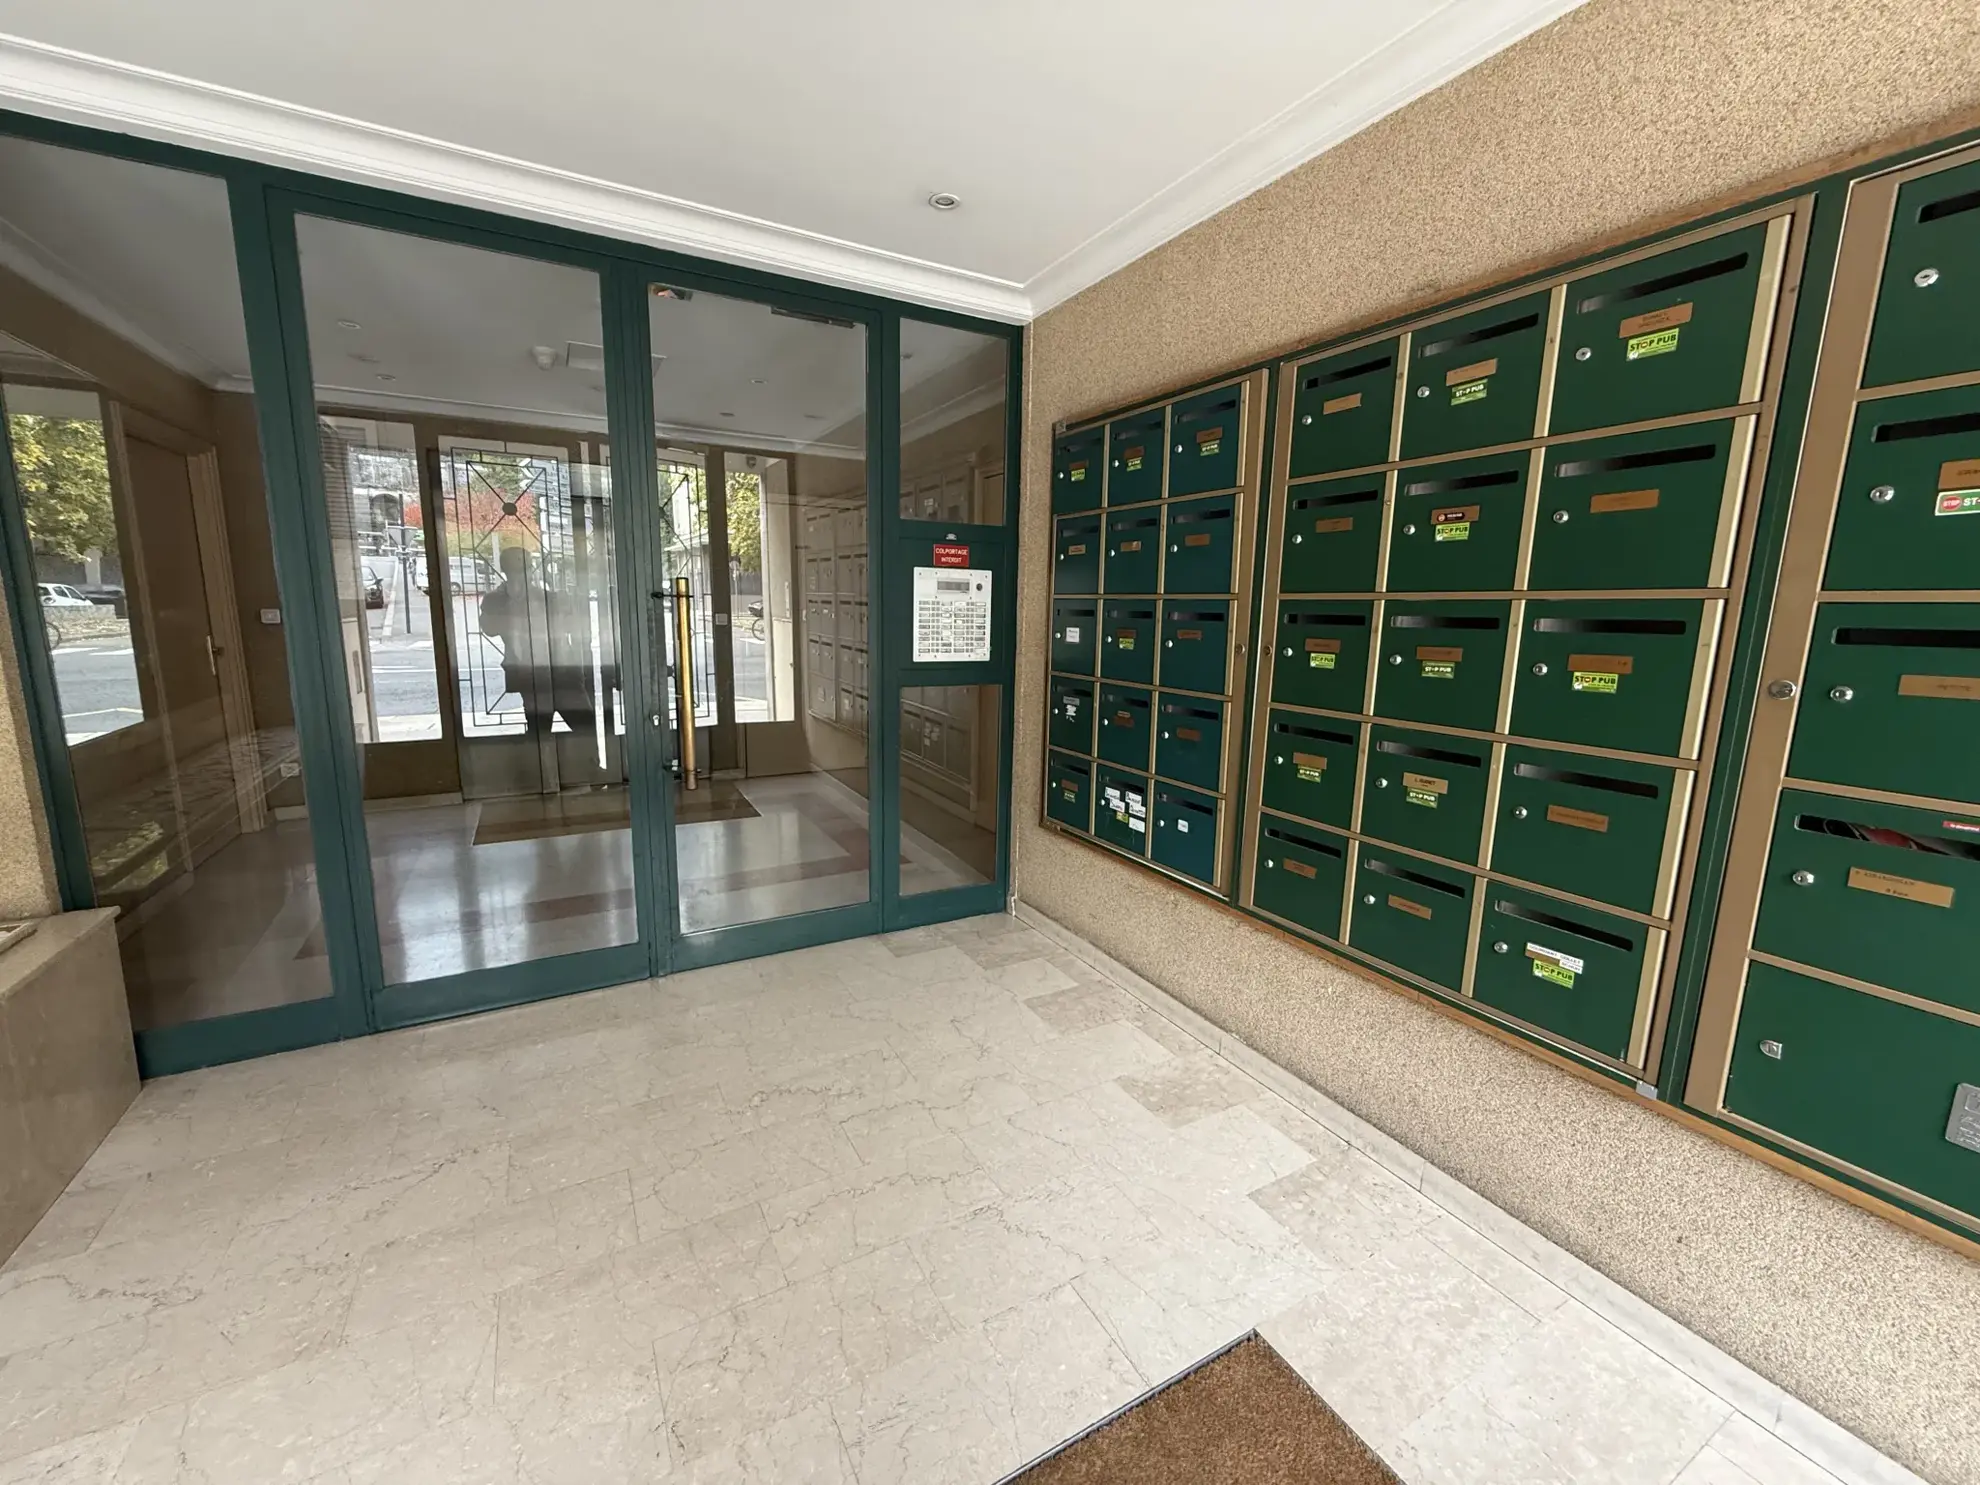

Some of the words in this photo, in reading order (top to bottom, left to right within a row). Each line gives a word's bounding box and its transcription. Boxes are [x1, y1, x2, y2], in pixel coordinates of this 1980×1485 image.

[1630, 339, 1655, 352] STOP
[1657, 334, 1677, 345] PUB
[1471, 384, 1484, 393] PUB
[1437, 527, 1454, 535] STOP
[935, 547, 968, 556] COLPORTAGE
[941, 556, 962, 564] INTERDIT
[1575, 675, 1597, 684] STOP
[1598, 677, 1616, 685] PUB
[1535, 963, 1556, 974] STOP
[1556, 970, 1573, 981] PUB
